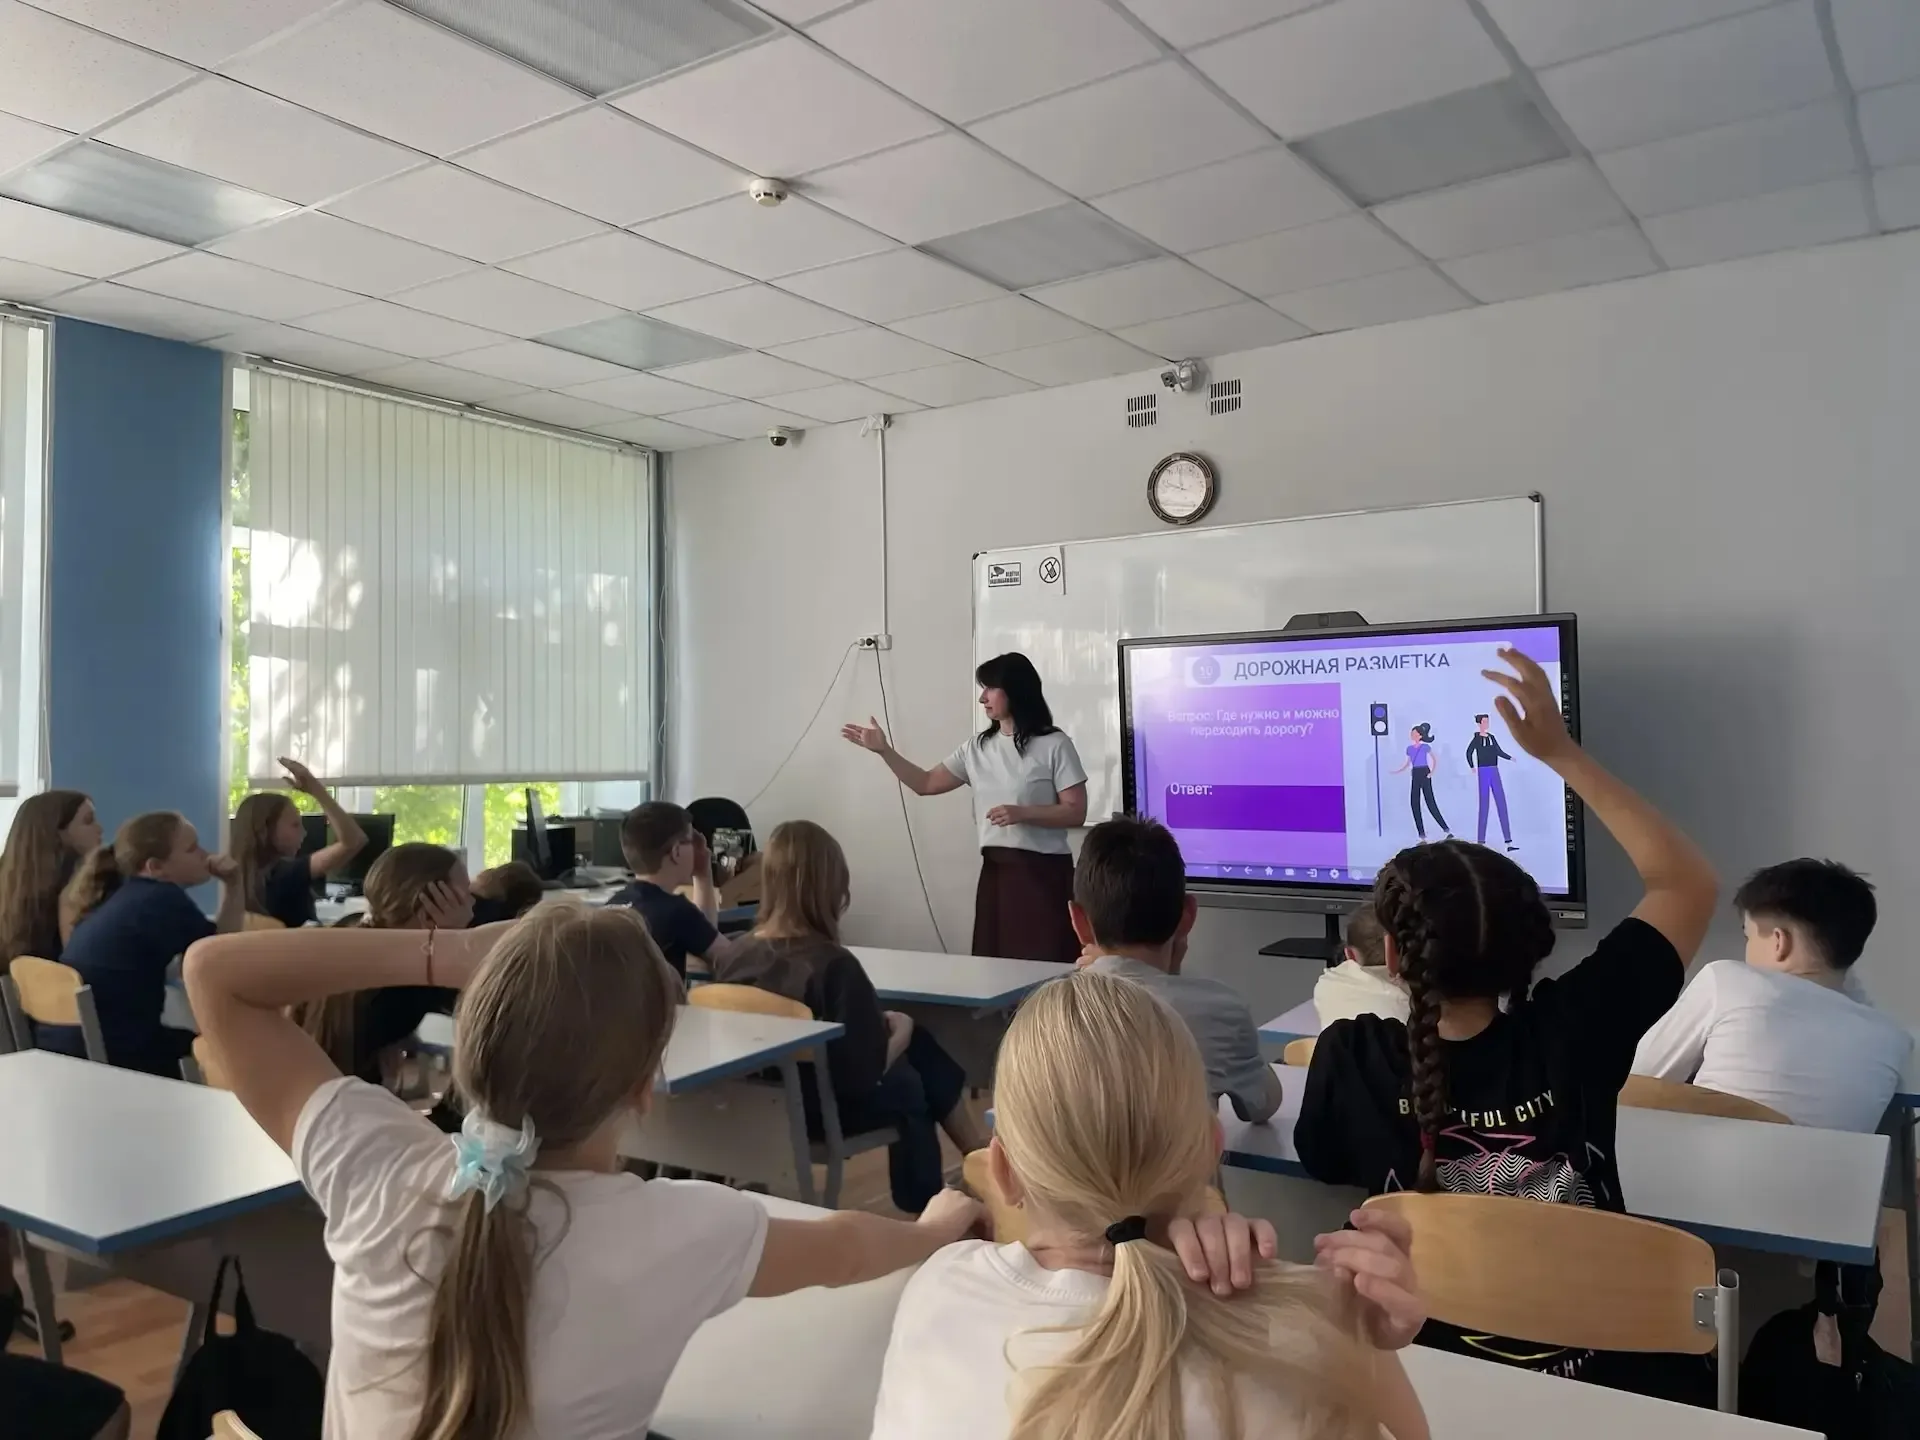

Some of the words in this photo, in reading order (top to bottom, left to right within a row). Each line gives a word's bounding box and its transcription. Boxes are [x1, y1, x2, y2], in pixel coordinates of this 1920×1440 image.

[1234, 657, 1339, 680] ДОРОЖНАЯ
[1217, 709, 1236, 722] Где
[1241, 709, 1279, 722] нужно
[1283, 710, 1290, 719] и
[1294, 708, 1339, 720] можно
[1191, 724, 1260, 738] переходить
[1264, 722, 1313, 737] дорогу?
[1170, 782, 1213, 795] Ответ:
[1515, 1089, 1554, 1123] CITY
